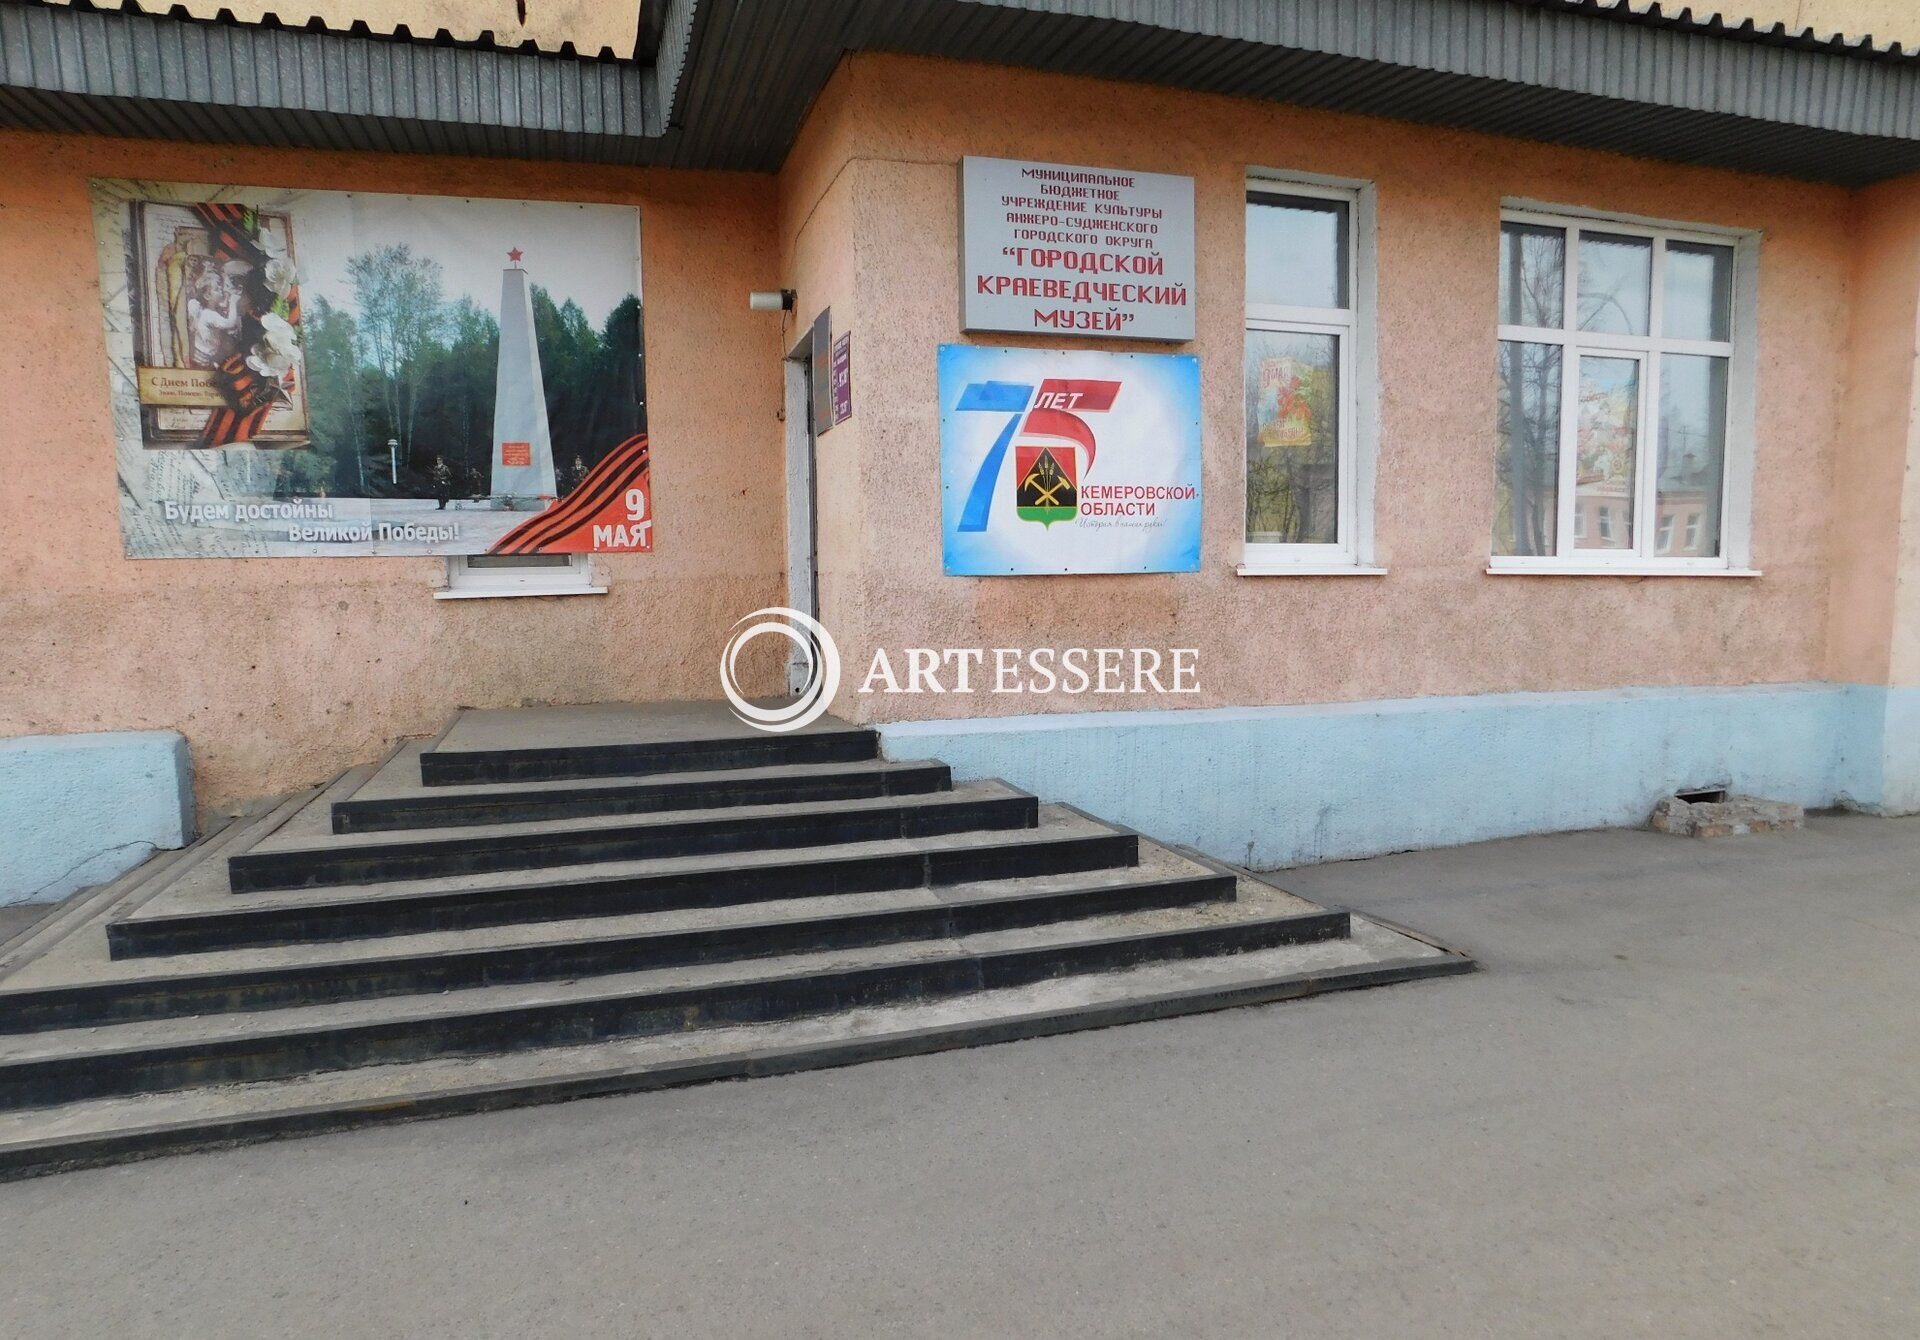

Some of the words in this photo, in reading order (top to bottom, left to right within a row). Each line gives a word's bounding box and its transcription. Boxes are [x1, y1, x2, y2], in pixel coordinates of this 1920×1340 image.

[1021, 168, 1136, 188] МУНИЦИПАЛЬНОЕ
[1040, 184, 1120, 200] БЮДЖЕТНОЕ
[1001, 196, 1088, 213] УЧРЕЖДЕНИЕ
[1094, 203, 1162, 219] КУЛЬТУРЫ
[1006, 212, 1158, 234] АНЖЕРО-СУДЖЕНСКОГО
[1014, 229, 1098, 245] ГОРОДСКОГО
[1105, 236, 1153, 249] ОКРУГА
[977, 275, 1187, 306] КРАЕВЕДЧЕСКИЙ
[1033, 392, 1083, 409] ЛЕТ
[1080, 483, 1195, 500] КЕМЕРОВСКОЙ
[164, 500, 229, 525] Будем
[235, 498, 333, 522] достойны
[625, 488, 645, 521] 9
[1080, 502, 1155, 516] ОБЛАСТИ
[289, 522, 372, 542] Великой
[378, 522, 460, 543] Победы!
[593, 520, 652, 547] МАЯ
